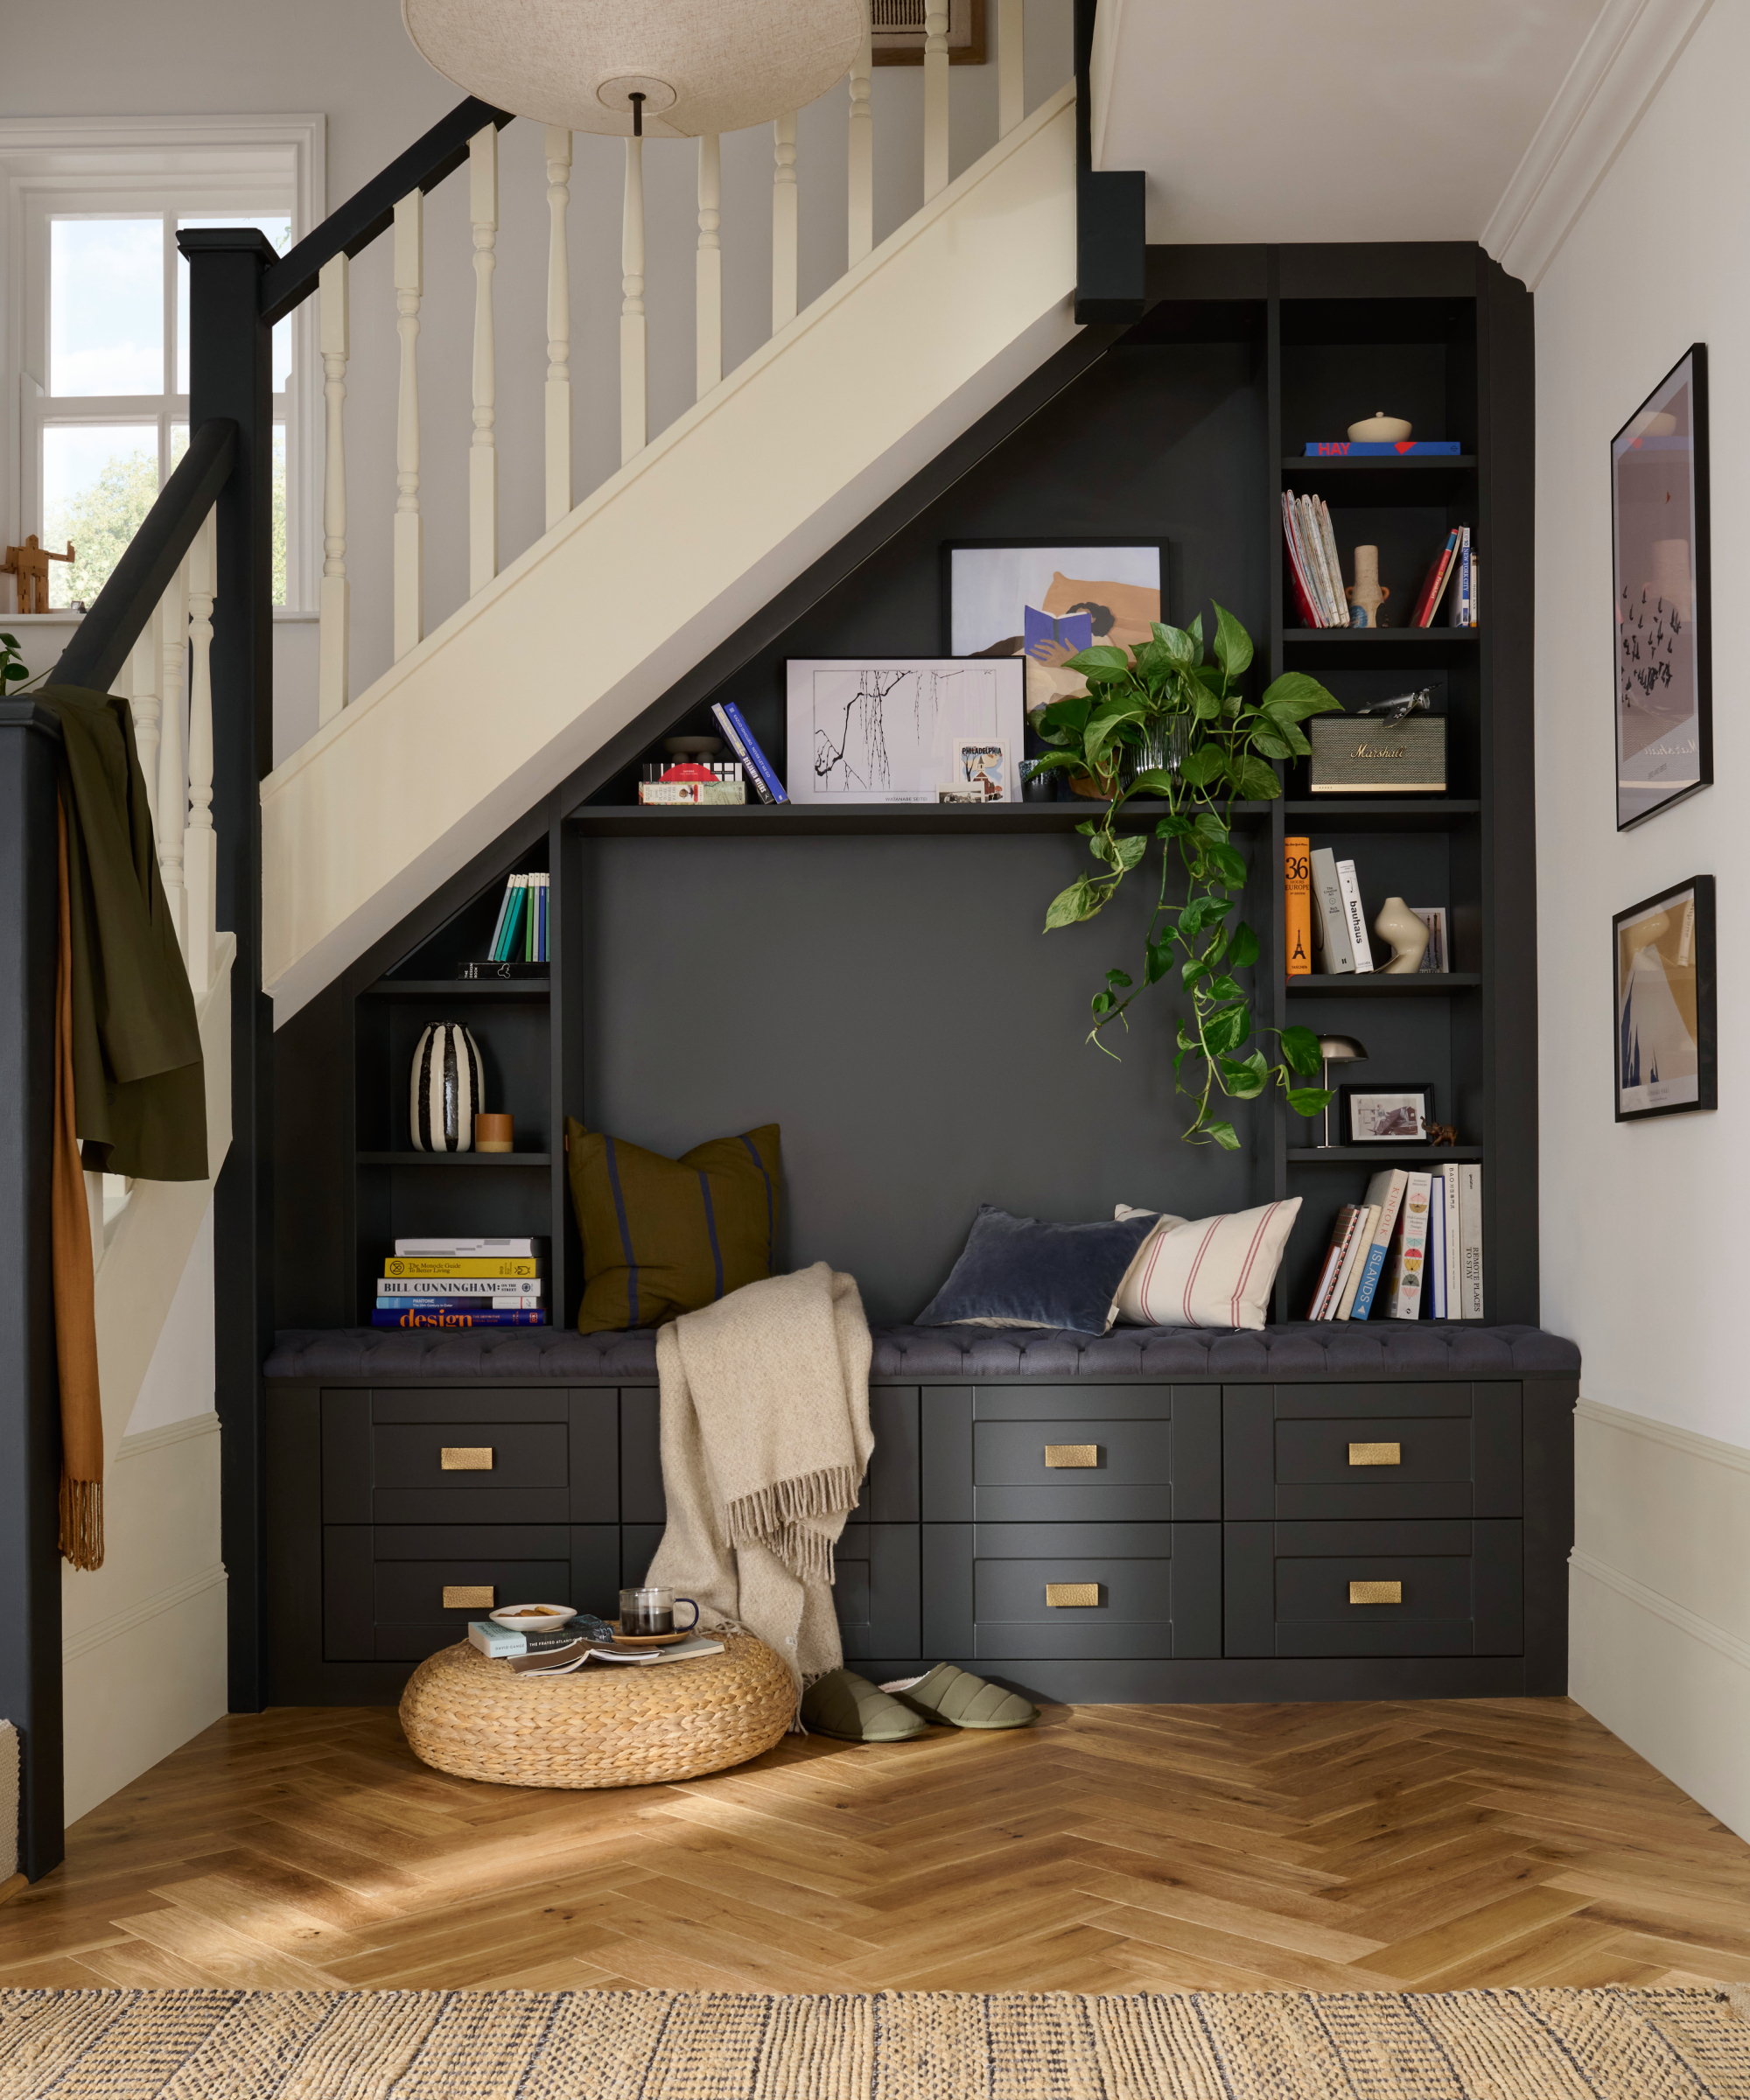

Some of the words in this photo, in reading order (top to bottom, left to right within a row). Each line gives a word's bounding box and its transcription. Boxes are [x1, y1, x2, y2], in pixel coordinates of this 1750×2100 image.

[1318, 443, 1350, 456] HAY
[733, 714, 743, 727] KAZUO
[740, 727, 752, 746] ISHIGURO
[752, 746, 760, 760] NEVER
[1350, 744, 1407, 759] Marshall
[743, 756, 759, 779] BENJAMIN
[754, 778, 766, 793] MYERS
[1285, 857, 1308, 880] 36
[1349, 900, 1362, 944] bauhaus
[1380, 1186, 1400, 1236] KINFOLK
[1466, 1247, 1472, 1259] TO
[384, 1284, 410, 1292] BILL
[414, 1283, 500, 1292] CUNNINGHAM:
[1360, 1250, 1383, 1304] ISLANDS
[400, 1309, 472, 1327] design
